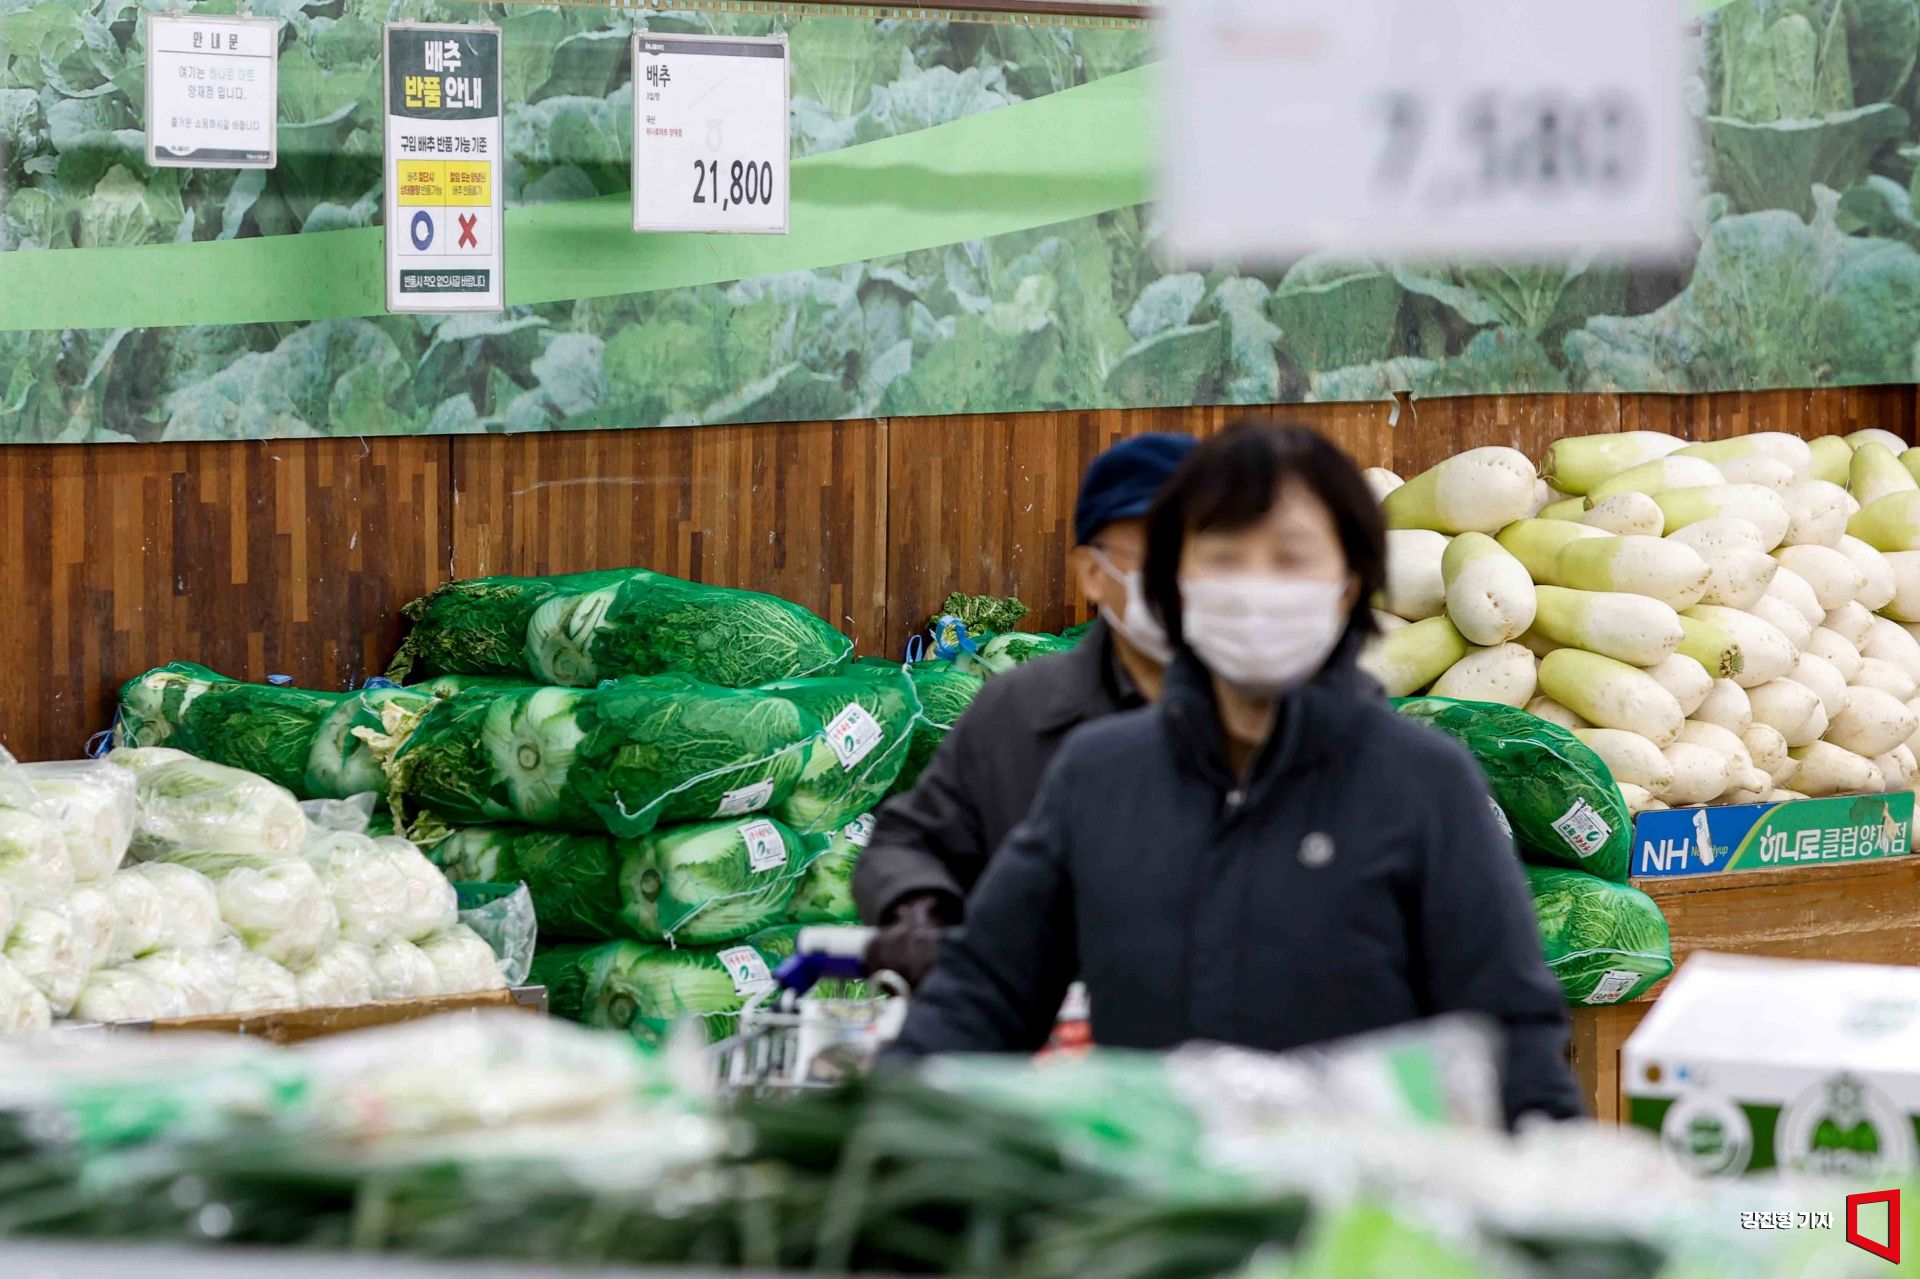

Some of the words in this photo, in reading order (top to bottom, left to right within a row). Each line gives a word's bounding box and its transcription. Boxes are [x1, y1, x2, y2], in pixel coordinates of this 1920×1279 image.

[424, 39, 461, 72] 배추
[178, 65, 205, 79] 여기는
[646, 64, 671, 88] 배추
[405, 76, 441, 108] 반품
[445, 76, 482, 109] 안내
[401, 136, 416, 152] 구입
[418, 136, 435, 152] 배추
[437, 136, 453, 152] 반품
[455, 136, 471, 153] 가능
[472, 137, 487, 153] 기준
[693, 159, 773, 211] 21,800
[404, 275, 422, 288] 반품시
[423, 275, 436, 288] 착오
[1641, 838, 1689, 873] NH
